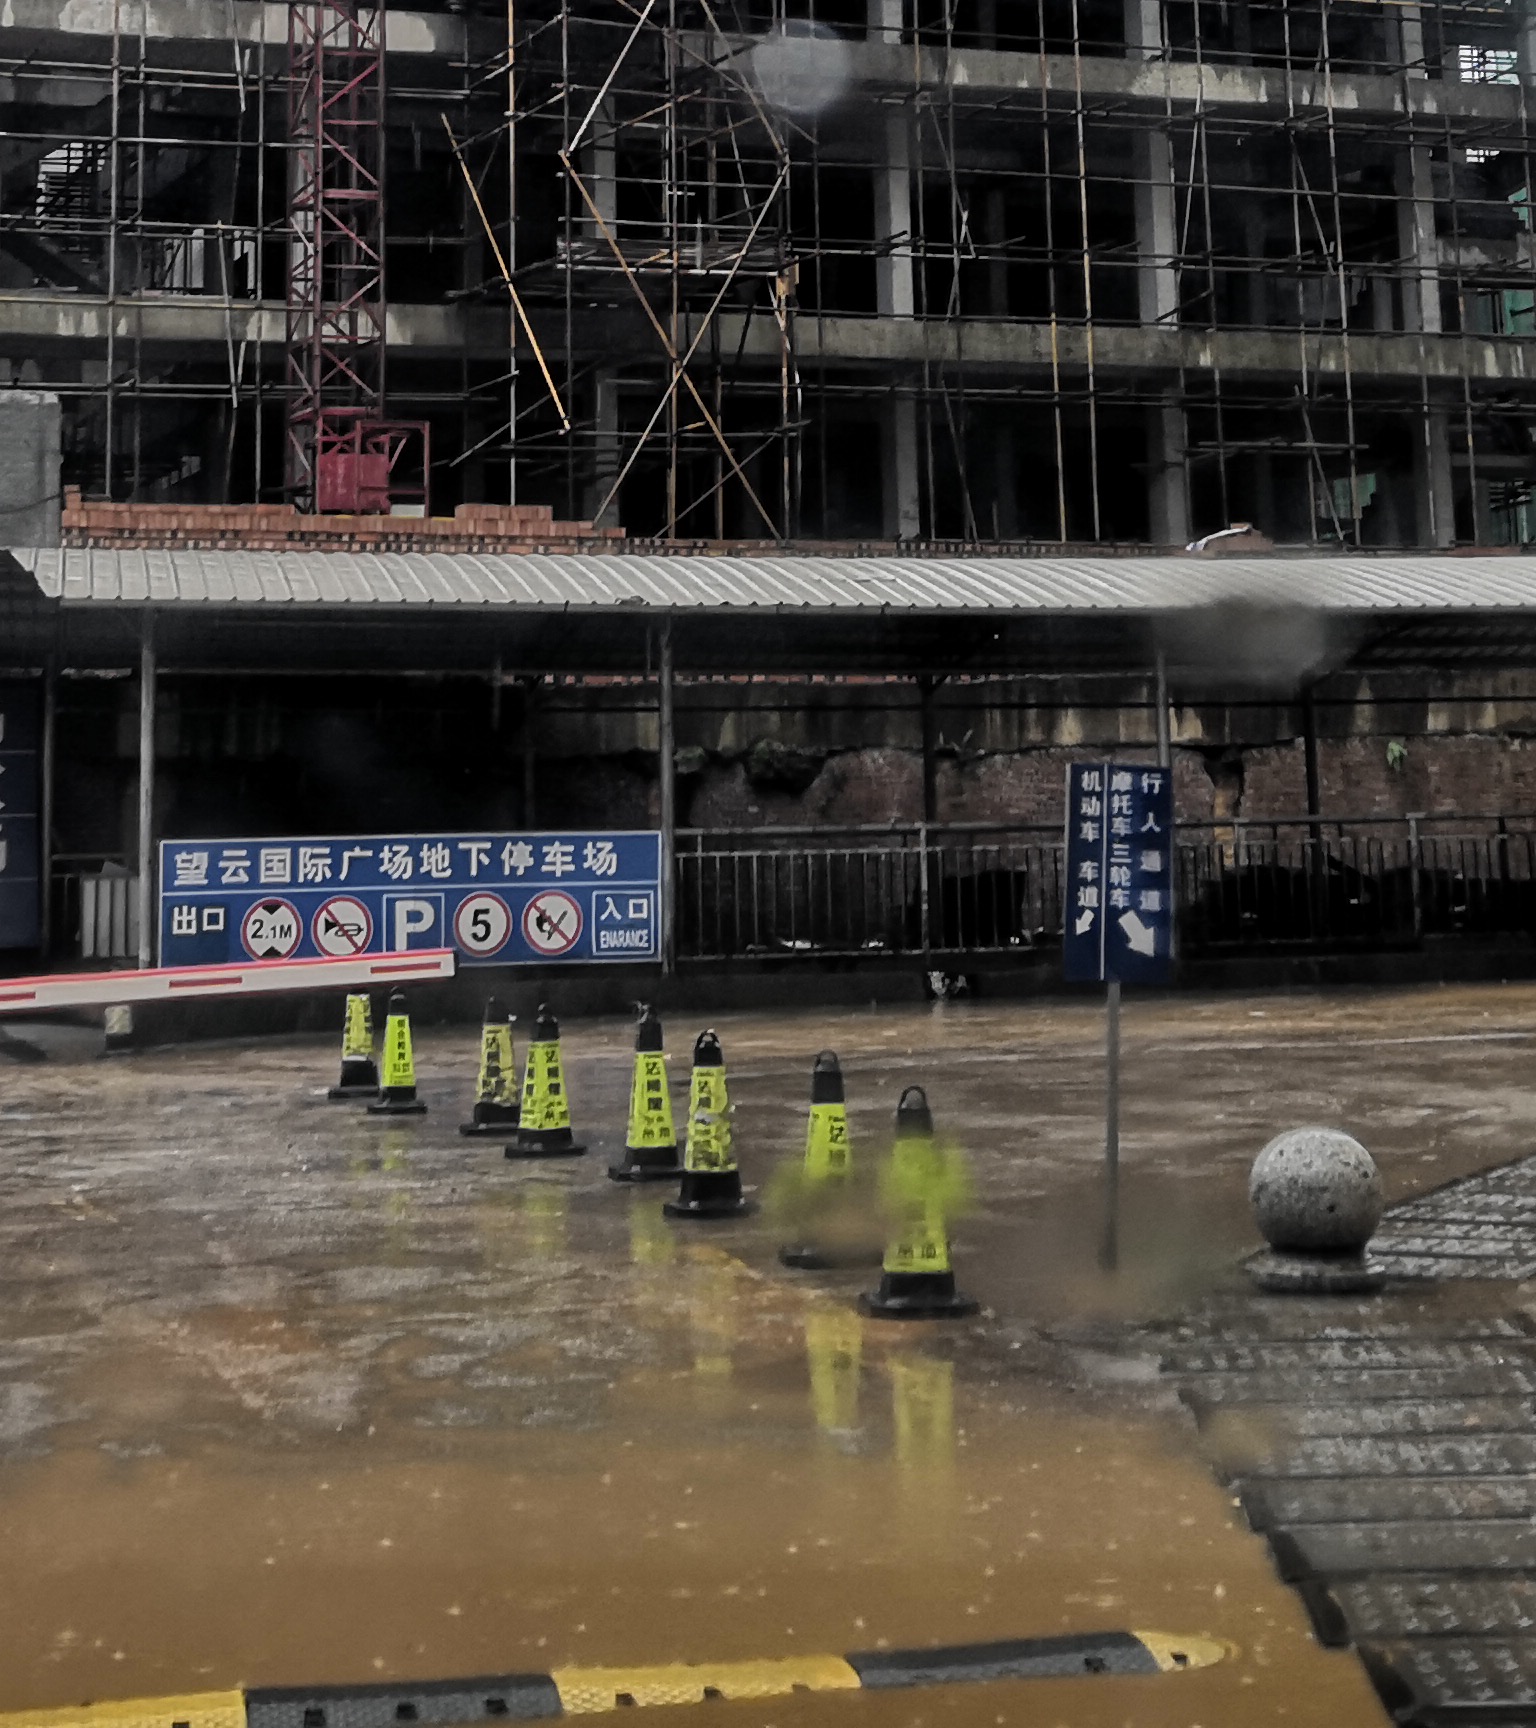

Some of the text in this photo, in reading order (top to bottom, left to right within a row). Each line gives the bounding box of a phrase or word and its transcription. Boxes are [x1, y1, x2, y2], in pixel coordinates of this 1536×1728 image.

[174, 841, 618, 887] 望云国际广场地下停车场
[172, 905, 225, 934] 出口
[394, 900, 436, 951] P
[470, 907, 492, 942] 5
[600, 896, 648, 920] 入口
